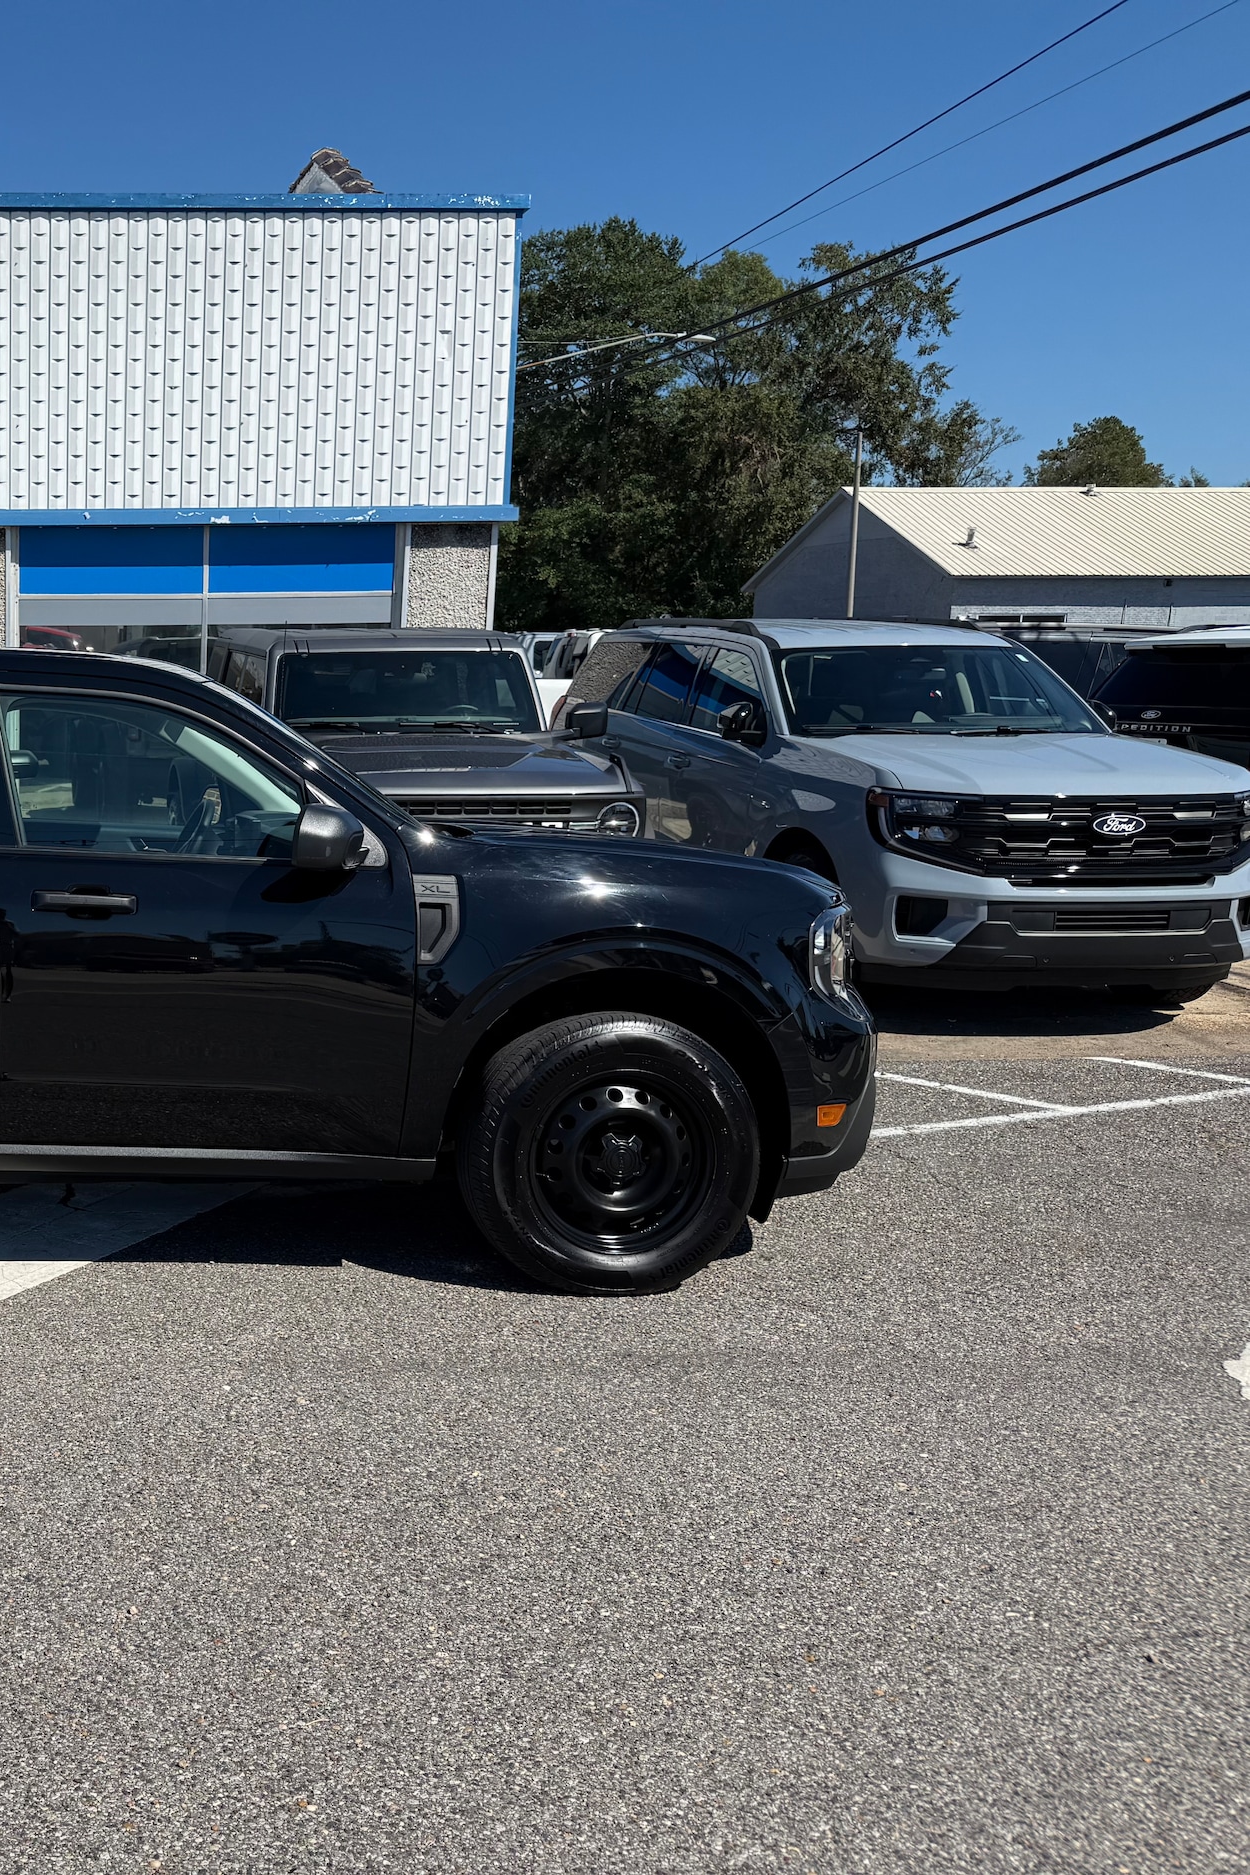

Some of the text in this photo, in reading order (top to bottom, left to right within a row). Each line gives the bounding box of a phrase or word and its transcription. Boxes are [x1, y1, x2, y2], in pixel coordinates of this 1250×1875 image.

[1103, 817, 1137, 832] Ford
[421, 884, 451, 894] XL
[521, 1044, 591, 1109] Continental
